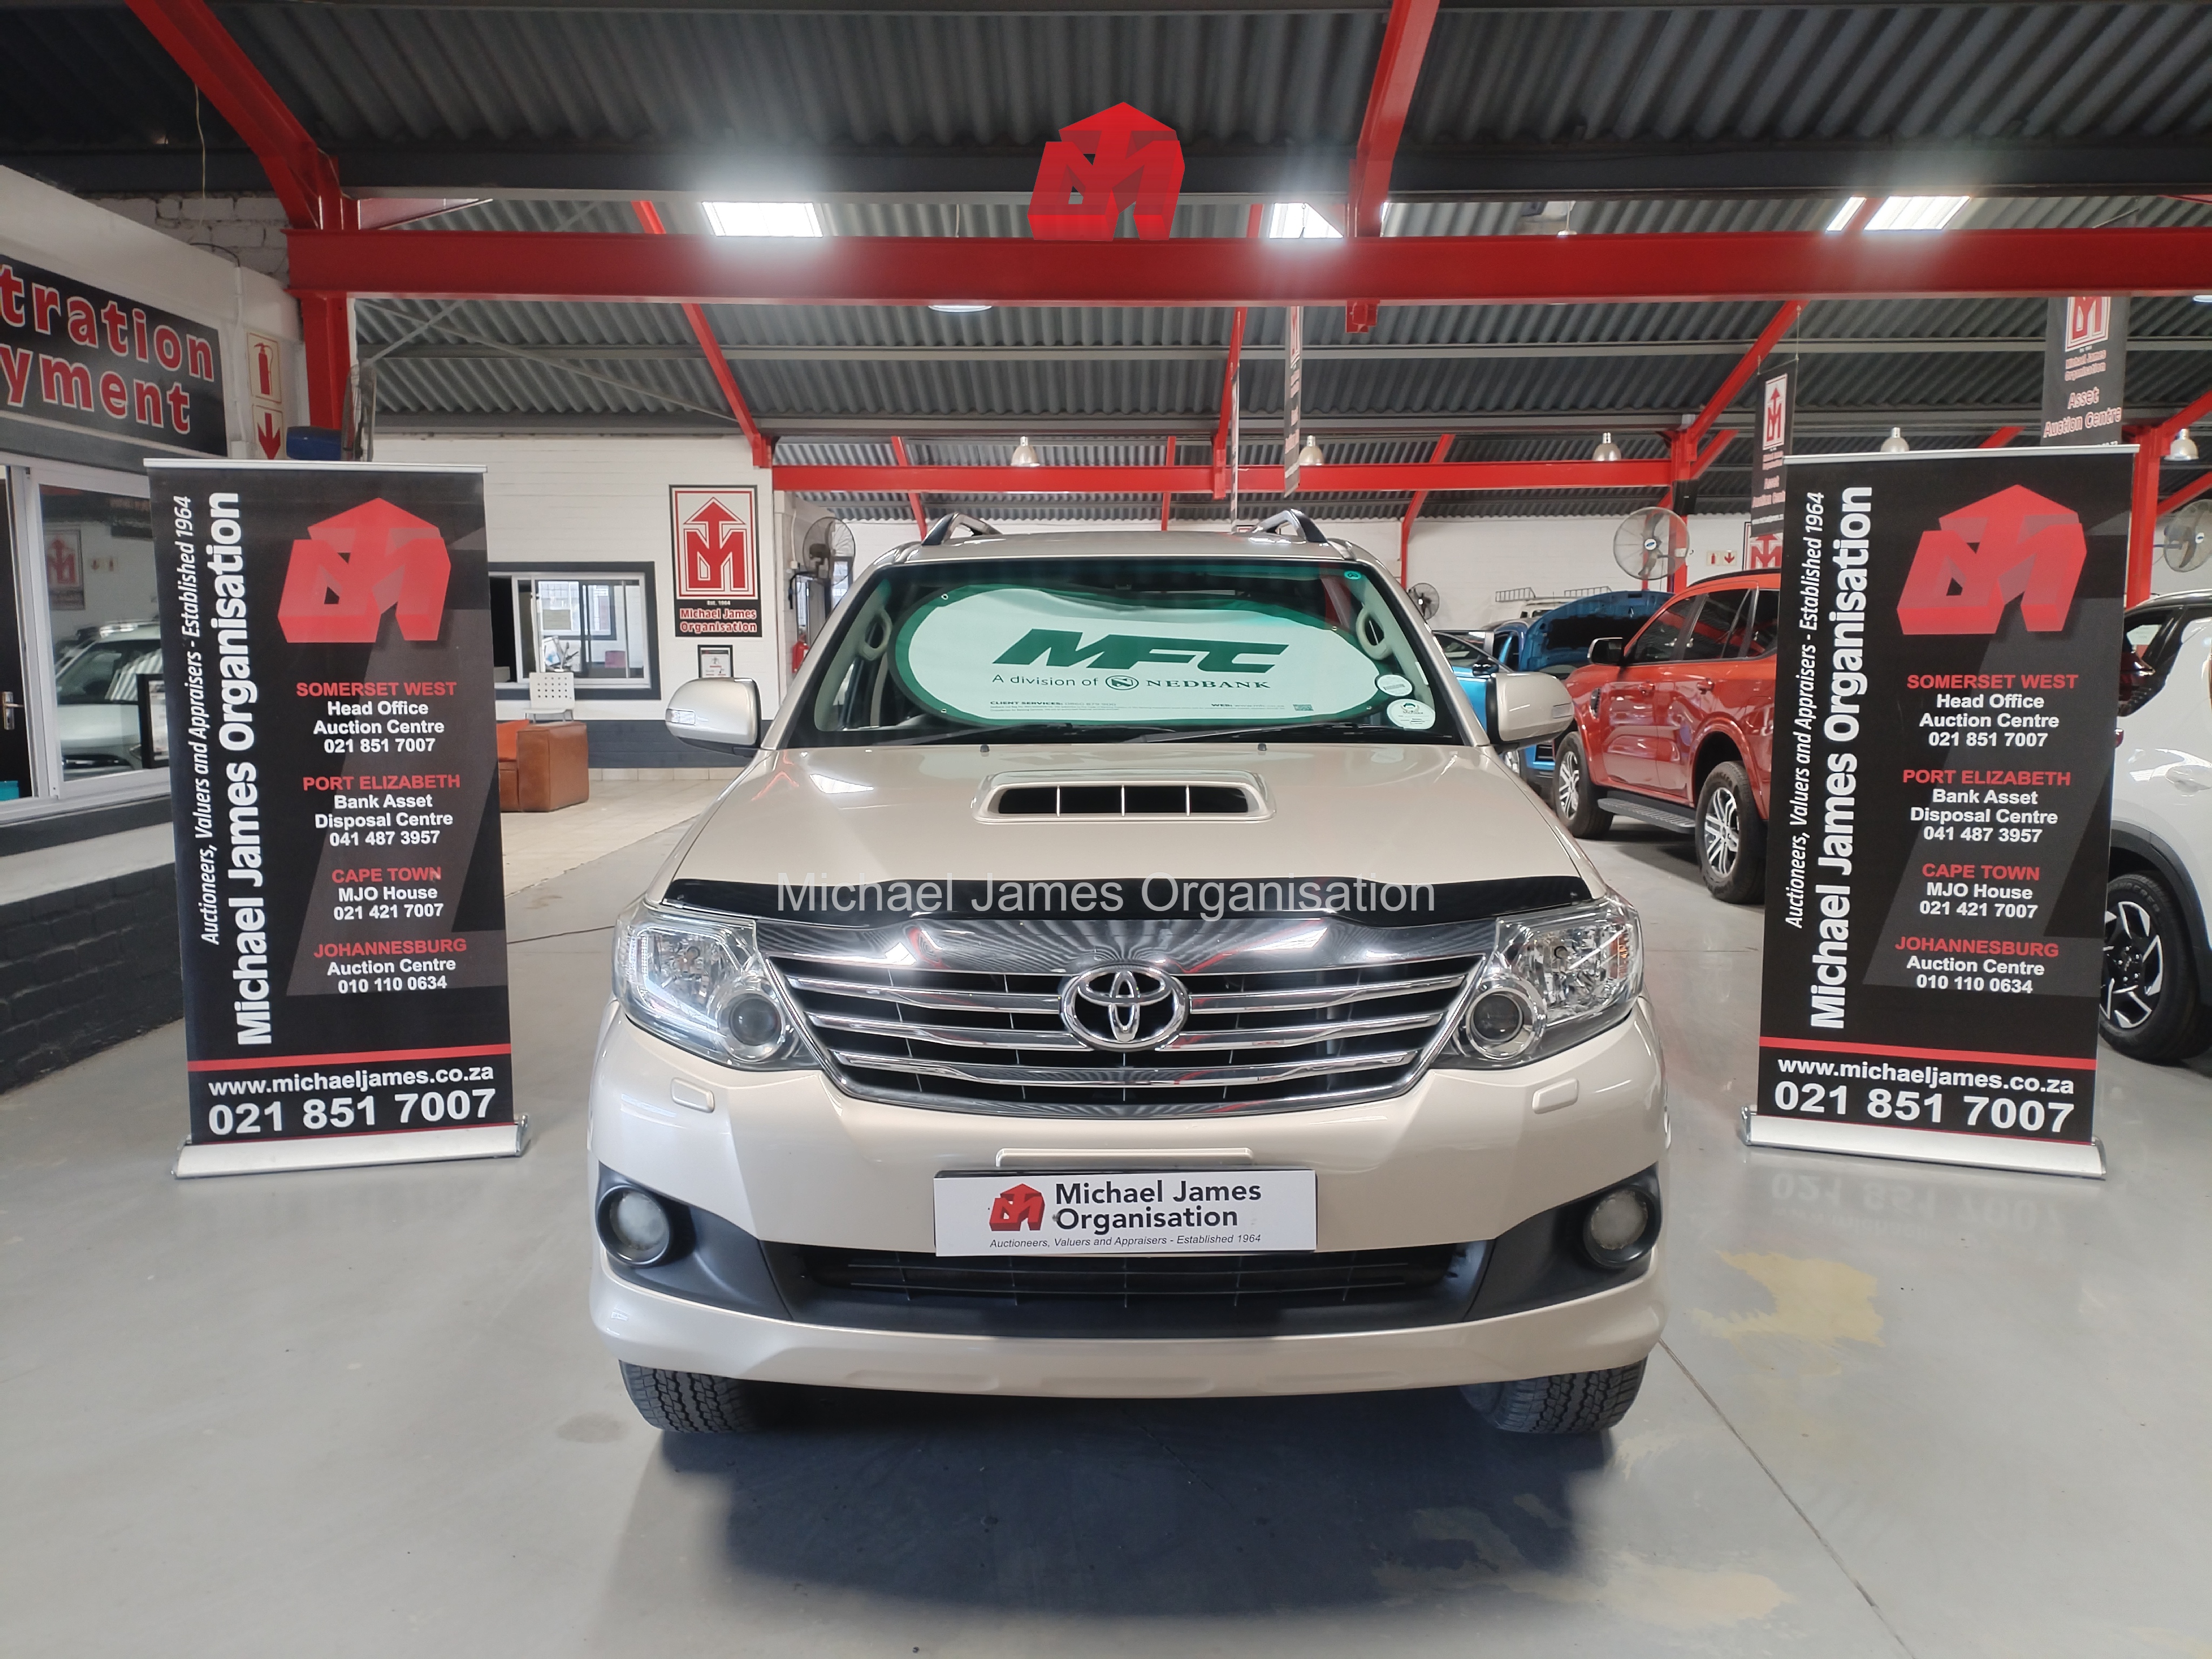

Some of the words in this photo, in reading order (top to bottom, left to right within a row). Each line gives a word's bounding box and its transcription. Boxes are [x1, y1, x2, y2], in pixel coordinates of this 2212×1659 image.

[0, 264, 214, 382] tration
[0, 343, 191, 434] yment
[2068, 387, 2100, 409] Asset
[2043, 416, 2082, 438] Auction
[2085, 407, 2121, 428] Centre
[173, 496, 194, 537] 1964
[1805, 492, 1824, 533] 1964
[174, 541, 200, 637] Established
[1799, 536, 1822, 631] Established
[206, 493, 258, 751] Organisation
[679, 608, 721, 619] Michael
[723, 608, 757, 619] James
[1824, 487, 1872, 741] Organisation
[680, 621, 757, 634] Organisation
[992, 629, 1289, 673] MFC
[296, 682, 400, 697] SOMERSET
[403, 681, 457, 697] WEST
[992, 674, 1004, 683] A
[1010, 676, 1075, 686] division
[1081, 677, 1098, 686] of
[1146, 680, 1270, 689] NEDBANK
[1794, 644, 1817, 730] Appraisers
[1906, 673, 2017, 690] SOMERSET
[2020, 673, 2079, 689] WEST
[184, 651, 210, 739] Appraisers
[1937, 693, 1984, 709] Head
[1989, 693, 2045, 709] Office
[327, 700, 373, 716] Head
[377, 700, 429, 716] Office
[313, 719, 382, 734] Auction
[387, 719, 445, 734] Centre
[1919, 712, 1992, 727] Auction
[1997, 712, 2060, 728] Centre
[324, 738, 354, 753] 021
[360, 738, 389, 753] 851
[395, 738, 436, 752] 7007
[1792, 731, 1811, 764] and
[1928, 732, 1959, 746] 021
[1966, 732, 1997, 747] 851
[2004, 732, 2048, 747] 7007
[188, 741, 209, 774] and
[302, 775, 355, 791] PORT
[359, 774, 461, 790] ELIZABETH
[1903, 768, 1957, 784] PORT
[1961, 770, 2071, 786] ELIZABETH
[334, 794, 380, 810] Bank
[383, 794, 433, 808] Asset
[1789, 767, 1810, 825] Valuers
[1932, 788, 1980, 804] Bank
[1983, 789, 2038, 805] Asset
[192, 778, 213, 838] Valuers
[1818, 753, 1857, 875] James
[1911, 807, 1991, 825] Disposal
[1996, 808, 2058, 824] Centre
[226, 762, 263, 887] James
[315, 812, 391, 831] Disposal
[396, 812, 453, 826] Centre
[329, 832, 359, 847] 041
[365, 831, 395, 846] 487
[400, 830, 441, 845] 3957
[1924, 826, 1954, 840] 041
[1960, 827, 1994, 841] 487
[1998, 828, 2043, 843] 3957
[332, 868, 383, 884] CAPE
[387, 866, 442, 882] TOWN
[1785, 832, 1810, 929] Auctioneers,
[1922, 863, 1975, 879] CAPE
[1980, 865, 2040, 881] TOWN
[198, 845, 219, 945] Auctioneers,
[338, 886, 379, 902] MJO
[383, 886, 438, 900] House
[1927, 882, 1968, 897] MJO
[1973, 884, 2033, 900] House
[333, 905, 363, 921] 021
[369, 904, 398, 919] 421
[403, 903, 444, 918] 7007
[1919, 900, 1950, 915] 021
[1956, 901, 1987, 916] 421
[1994, 903, 2039, 919] 7007
[314, 938, 467, 958] JOHANNESBURG
[1810, 884, 1850, 1029] Michael
[1895, 936, 2059, 958] JOHANNESBURG
[228, 897, 272, 1045] Michael
[327, 960, 395, 976] Auction
[399, 958, 456, 973] Centre
[1906, 955, 1978, 972] Auction
[1983, 959, 2045, 976] Centre
[338, 979, 369, 994] 010
[374, 977, 403, 992] 110
[407, 975, 448, 990] 0634
[1916, 974, 1948, 989] 010
[1954, 976, 1985, 991] 110
[1989, 977, 2033, 994] 0634
[208, 1066, 494, 1097] www.michaeljames.co.za
[1777, 1058, 2074, 1094] www.michaeljames.co.za
[208, 1101, 282, 1135] 021
[303, 1095, 375, 1129] 851
[394, 1088, 496, 1123] 7007
[1775, 1081, 1847, 1115] 021
[1867, 1088, 1942, 1123] 851
[1964, 1096, 2074, 1132] 7007
[1056, 1179, 1163, 1205] Michael
[1172, 1180, 1262, 1202] James
[1056, 1205, 1238, 1234] Organisation
[989, 1239, 1050, 1248] Auctioneers,
[1054, 1238, 1091, 1246] Valuers
[1094, 1237, 1112, 1245] and
[1114, 1237, 1167, 1247] Appraisers
[1177, 1235, 1234, 1244] Established
[1238, 1234, 1261, 1243] 1964
